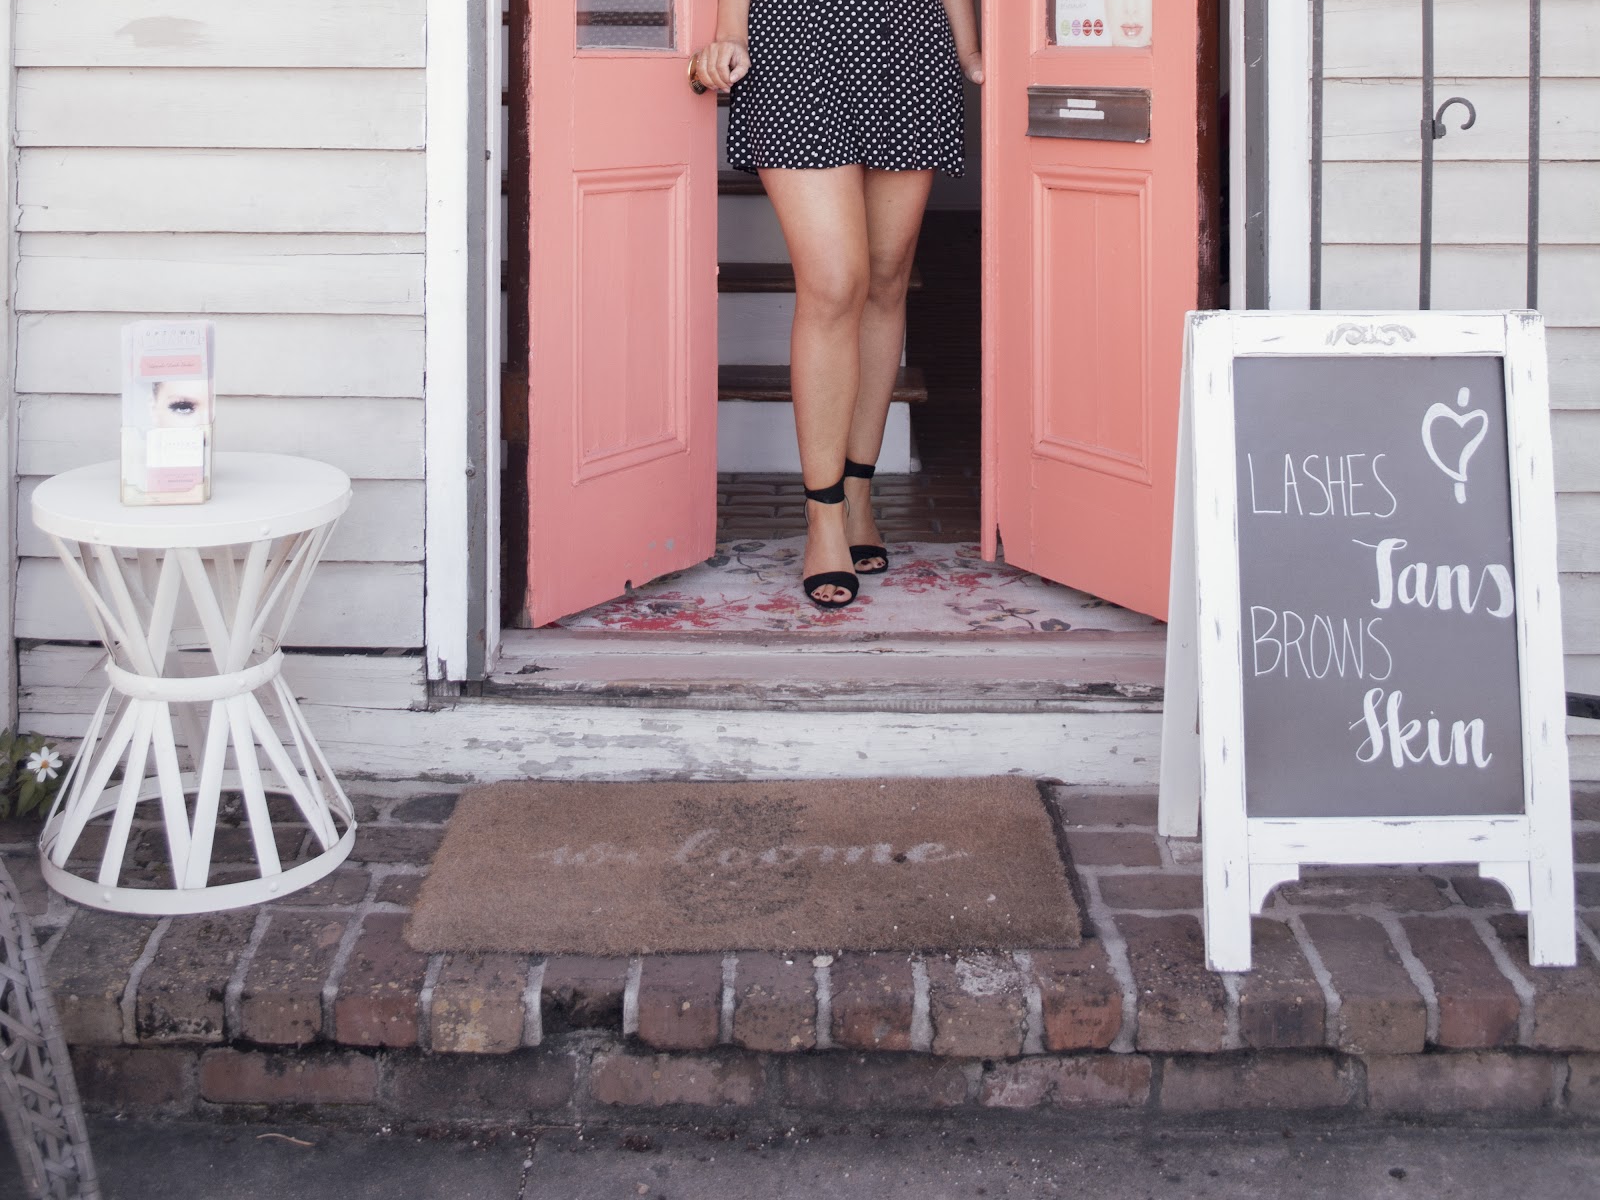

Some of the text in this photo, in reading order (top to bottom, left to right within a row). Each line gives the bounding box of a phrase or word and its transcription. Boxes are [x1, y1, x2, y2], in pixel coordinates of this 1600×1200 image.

[1247, 453, 1397, 518] LASHES
[1352, 537, 1515, 618] Tans
[1250, 605, 1393, 680] BROWS
[1348, 686, 1493, 768] Skin
